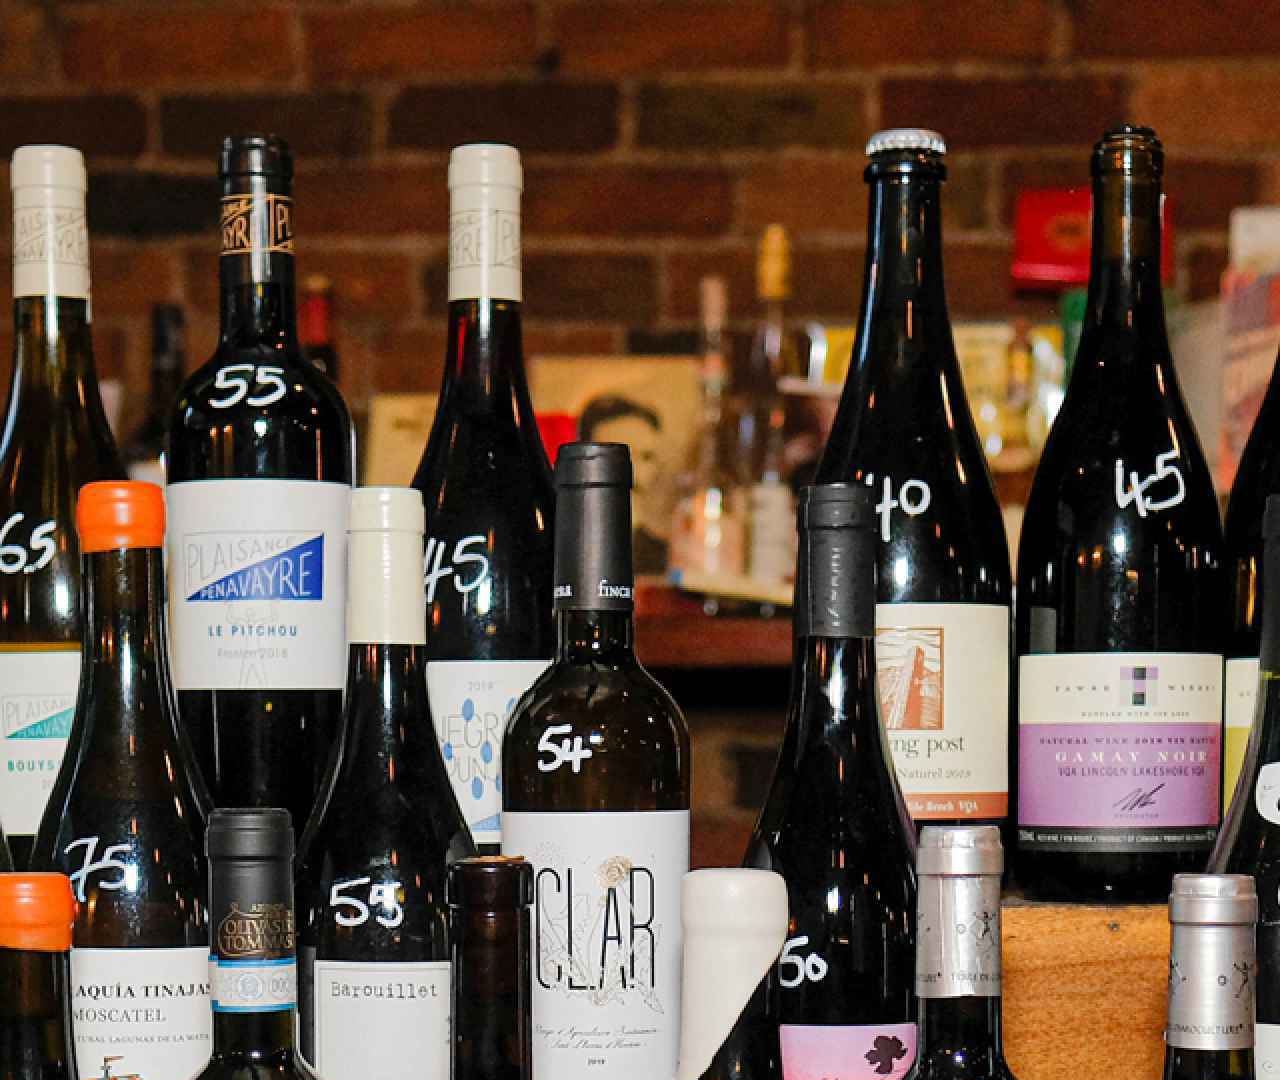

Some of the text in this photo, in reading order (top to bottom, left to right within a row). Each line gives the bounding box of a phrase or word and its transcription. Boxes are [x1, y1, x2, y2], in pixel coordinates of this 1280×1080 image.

[209, 364, 287, 409] 55
[1114, 449, 1187, 517] 45
[200, 551, 313, 599] PENAVAYRE
[208, 625, 298, 637] LE PITCHOU
[6, 759, 56, 772] BOUYS
[537, 724, 593, 773] 54
[927, 736, 967, 759] post
[1055, 751, 1208, 763] GAMAY NOIR
[1081, 766, 1128, 777] LINCOLN
[64, 836, 137, 903] 75
[330, 876, 405, 928] 55
[535, 866, 656, 992] CLAR
[779, 935, 829, 988] 50
[75, 981, 135, 1000] AQUÍA
[330, 981, 439, 999] Barouillet
